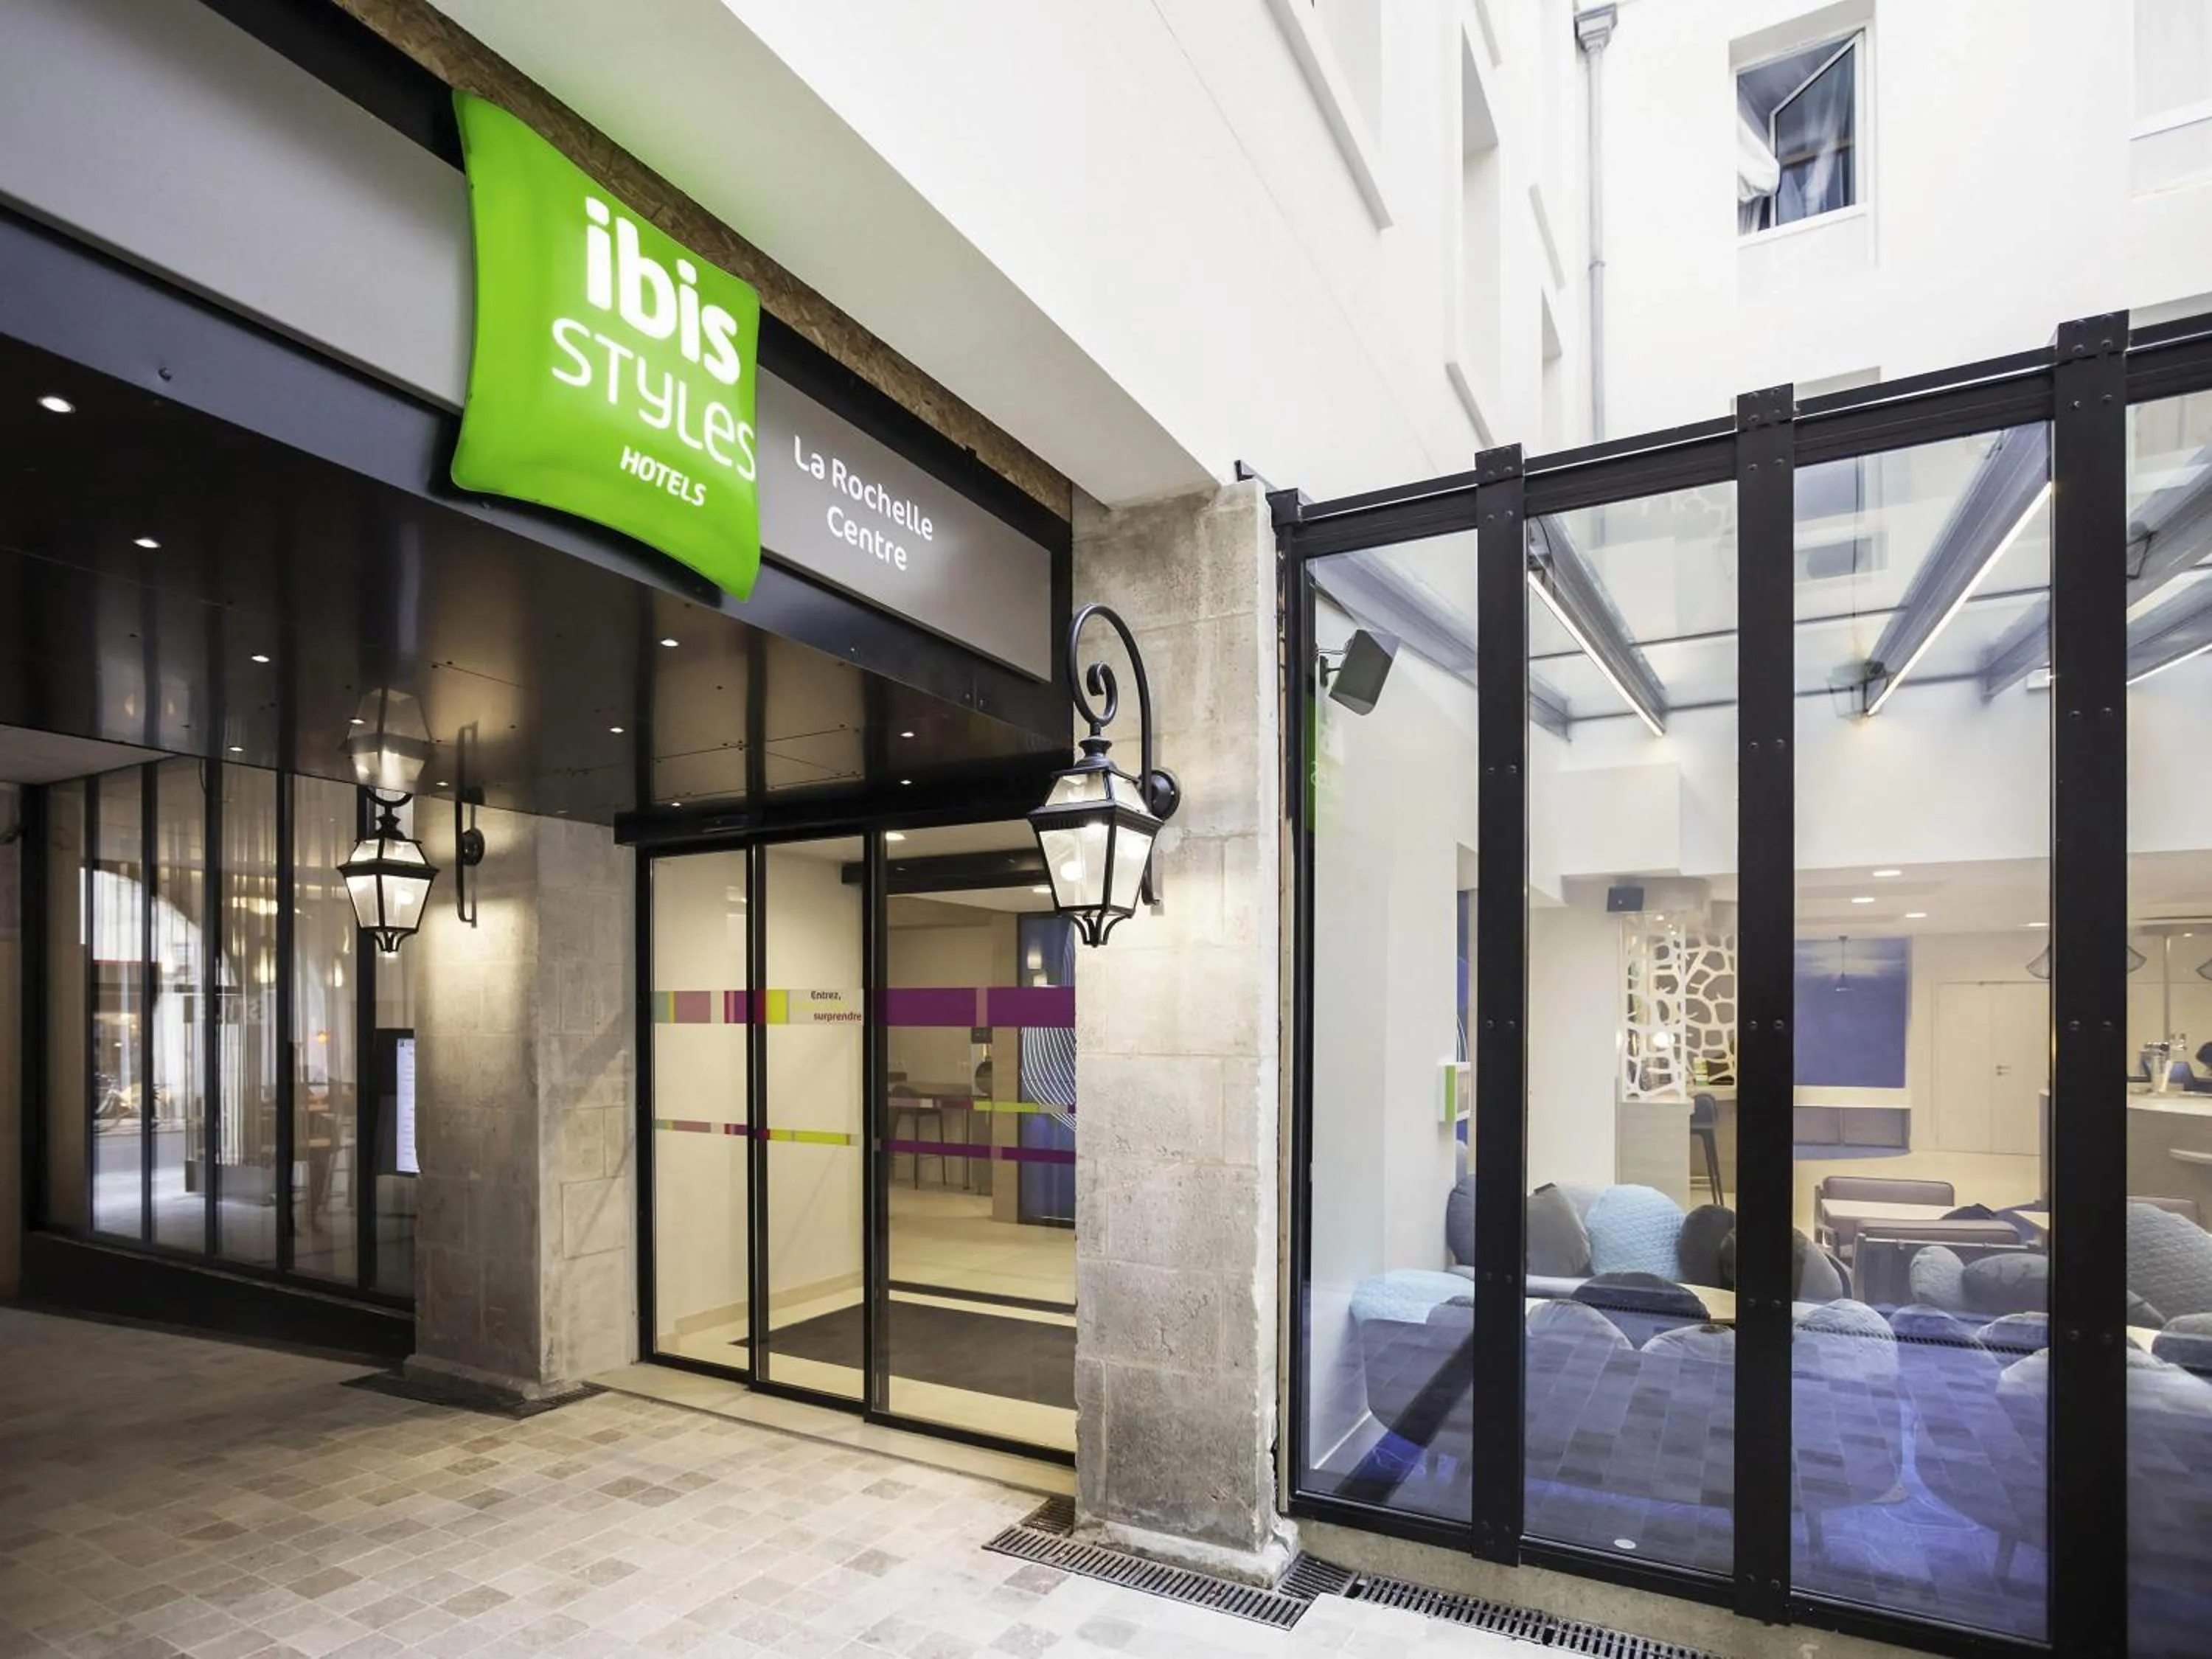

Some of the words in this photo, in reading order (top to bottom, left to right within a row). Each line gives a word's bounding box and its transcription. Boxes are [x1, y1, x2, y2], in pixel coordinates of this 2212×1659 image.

[585, 196, 741, 386] ibis
[619, 445, 707, 507] HOTELS
[794, 434, 826, 480] La
[832, 458, 933, 541] Rochelle
[827, 506, 908, 571] Centre
[810, 990, 841, 1001] Entrez,
[813, 1011, 862, 1023] surprendre
